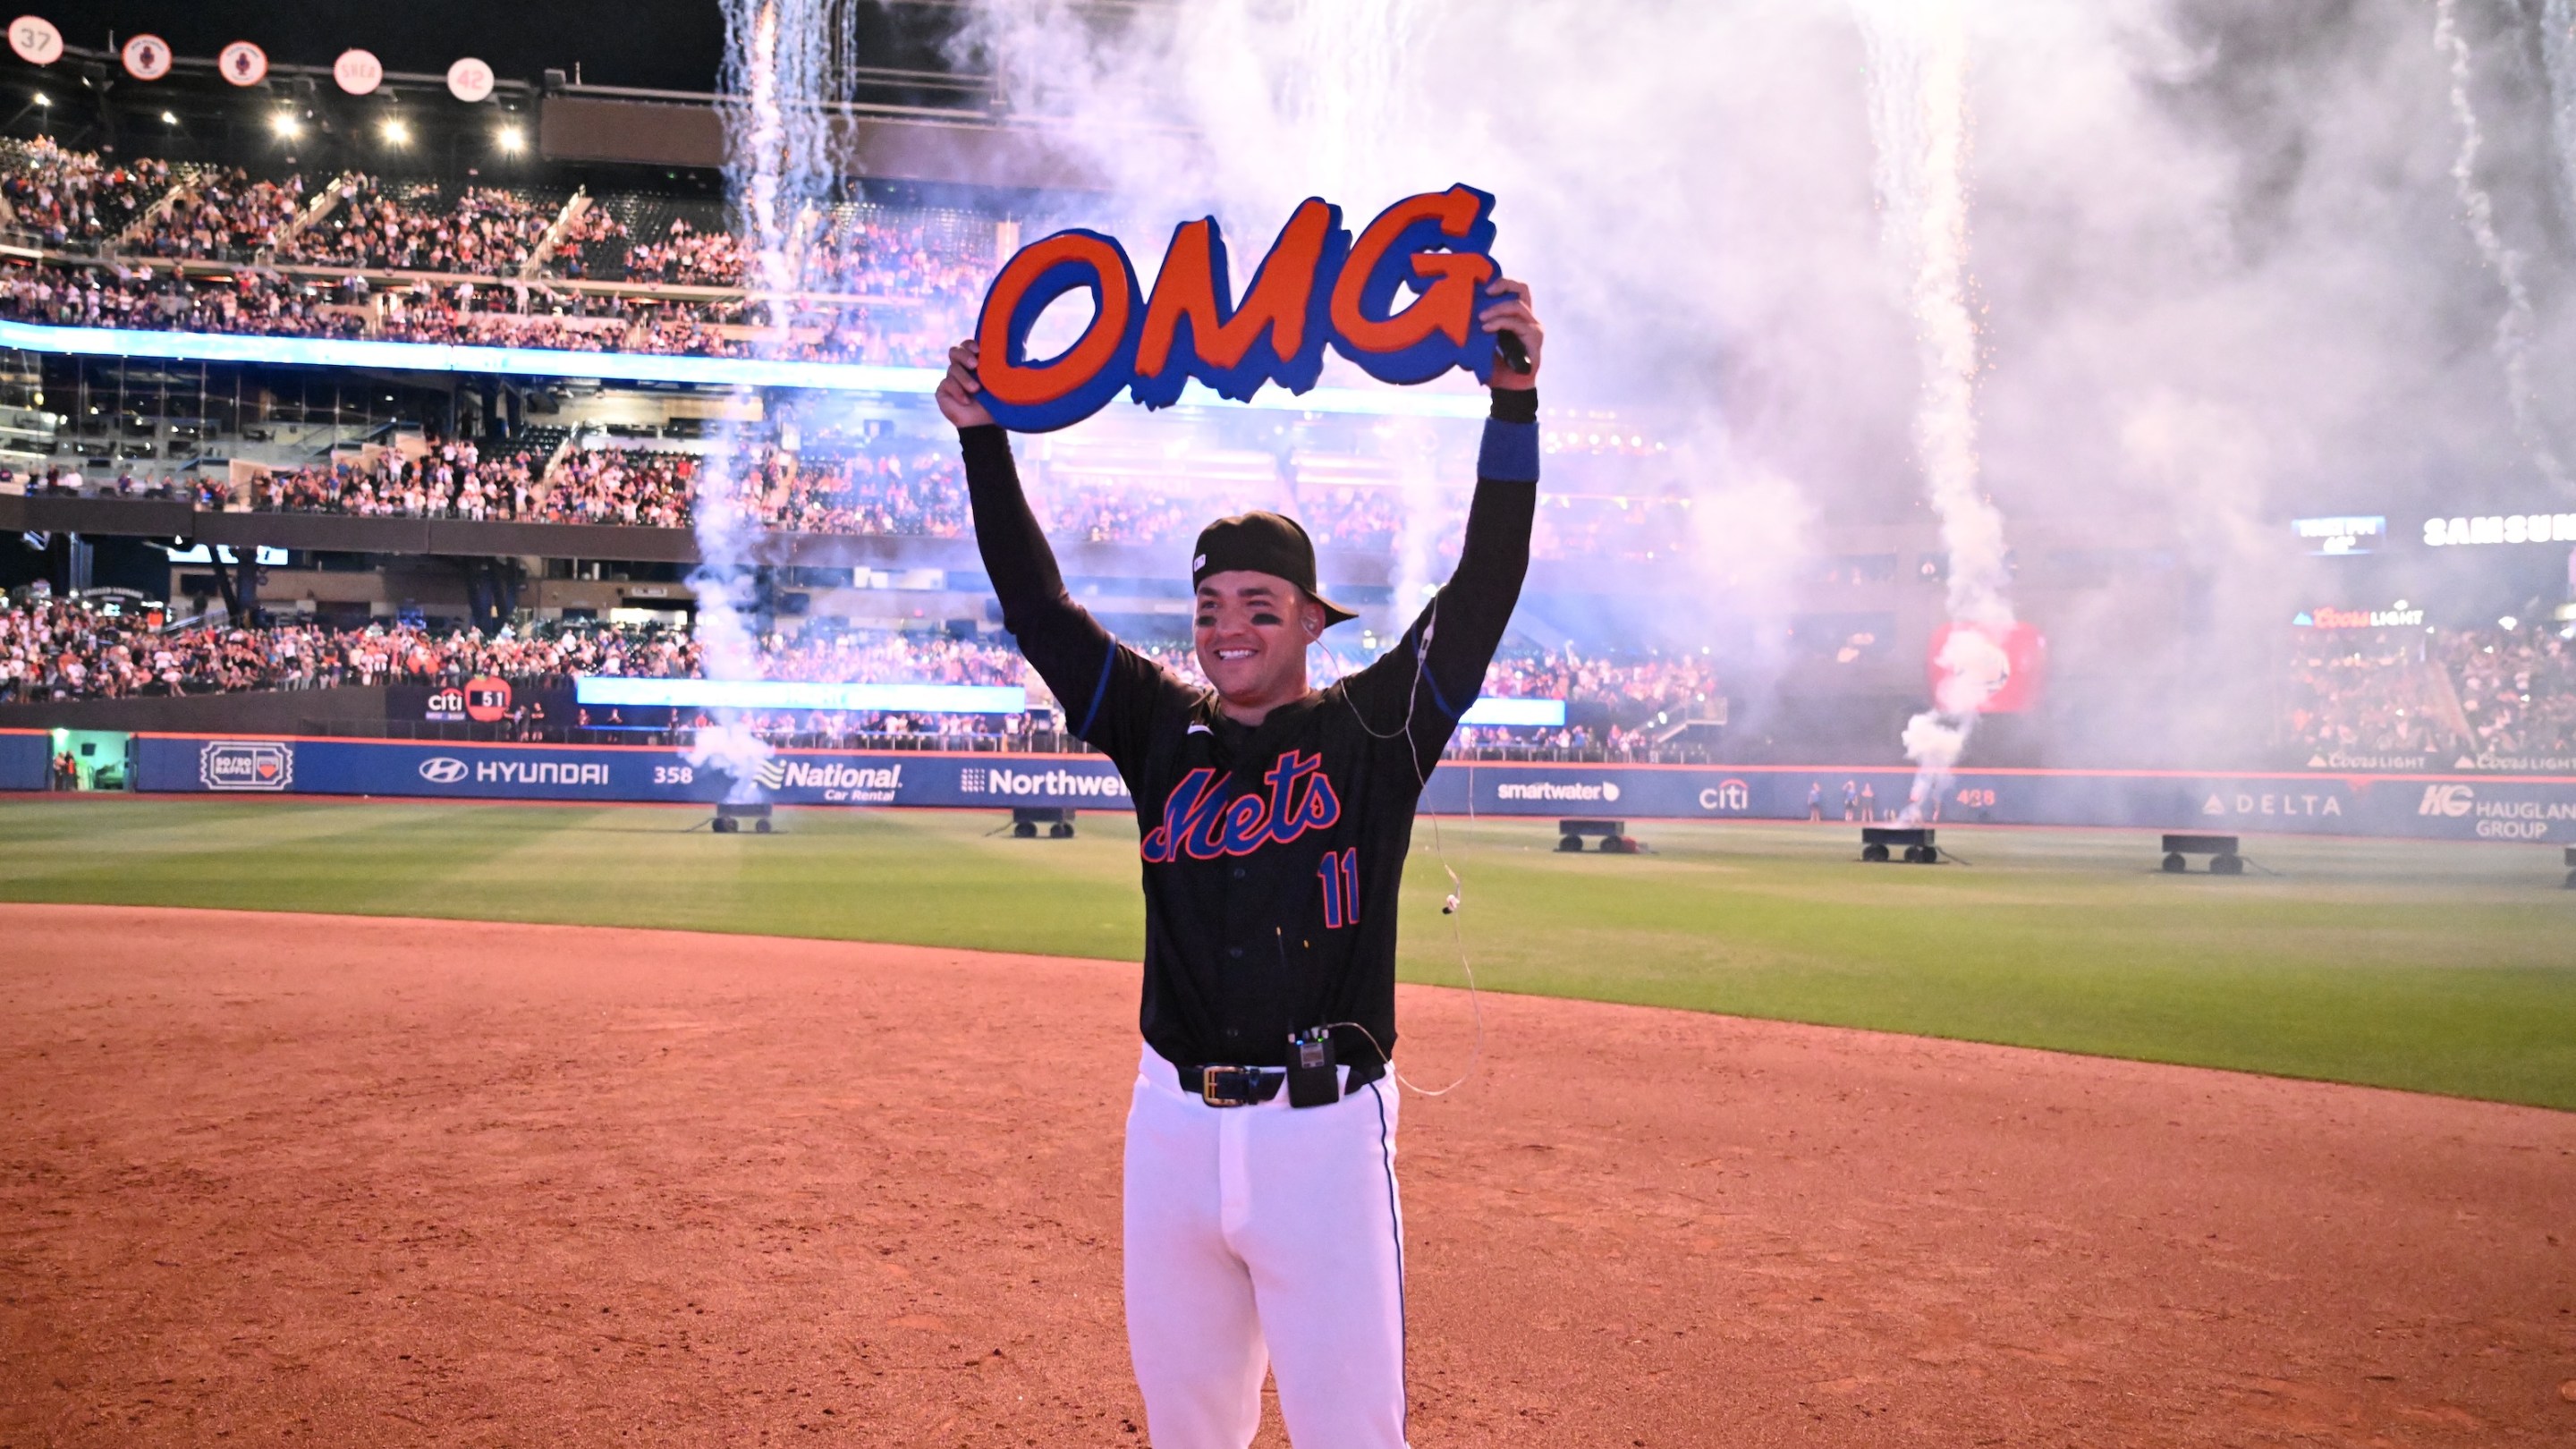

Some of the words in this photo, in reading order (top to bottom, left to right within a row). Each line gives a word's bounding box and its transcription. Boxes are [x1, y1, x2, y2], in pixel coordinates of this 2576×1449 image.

[21, 28, 51, 51] 37
[456, 69, 485, 90] 42
[977, 186, 1495, 405] OMG
[2370, 610, 2424, 626] LIGHT
[428, 688, 464, 711] citi
[483, 691, 504, 708] 51
[477, 760, 609, 785] HYUNDAI
[2380, 756, 2426, 769] LIGHT
[654, 766, 693, 784] 358
[989, 769, 1132, 797] Northwel
[825, 789, 848, 801] Car
[852, 789, 895, 802] Rental
[1497, 781, 1602, 801] smartwater
[1699, 778, 1749, 810] citi
[1140, 749, 1341, 863] Mets
[2236, 793, 2343, 817] DELTA
[2476, 819, 2548, 839] GROUP
[1317, 846, 1360, 928] 11
